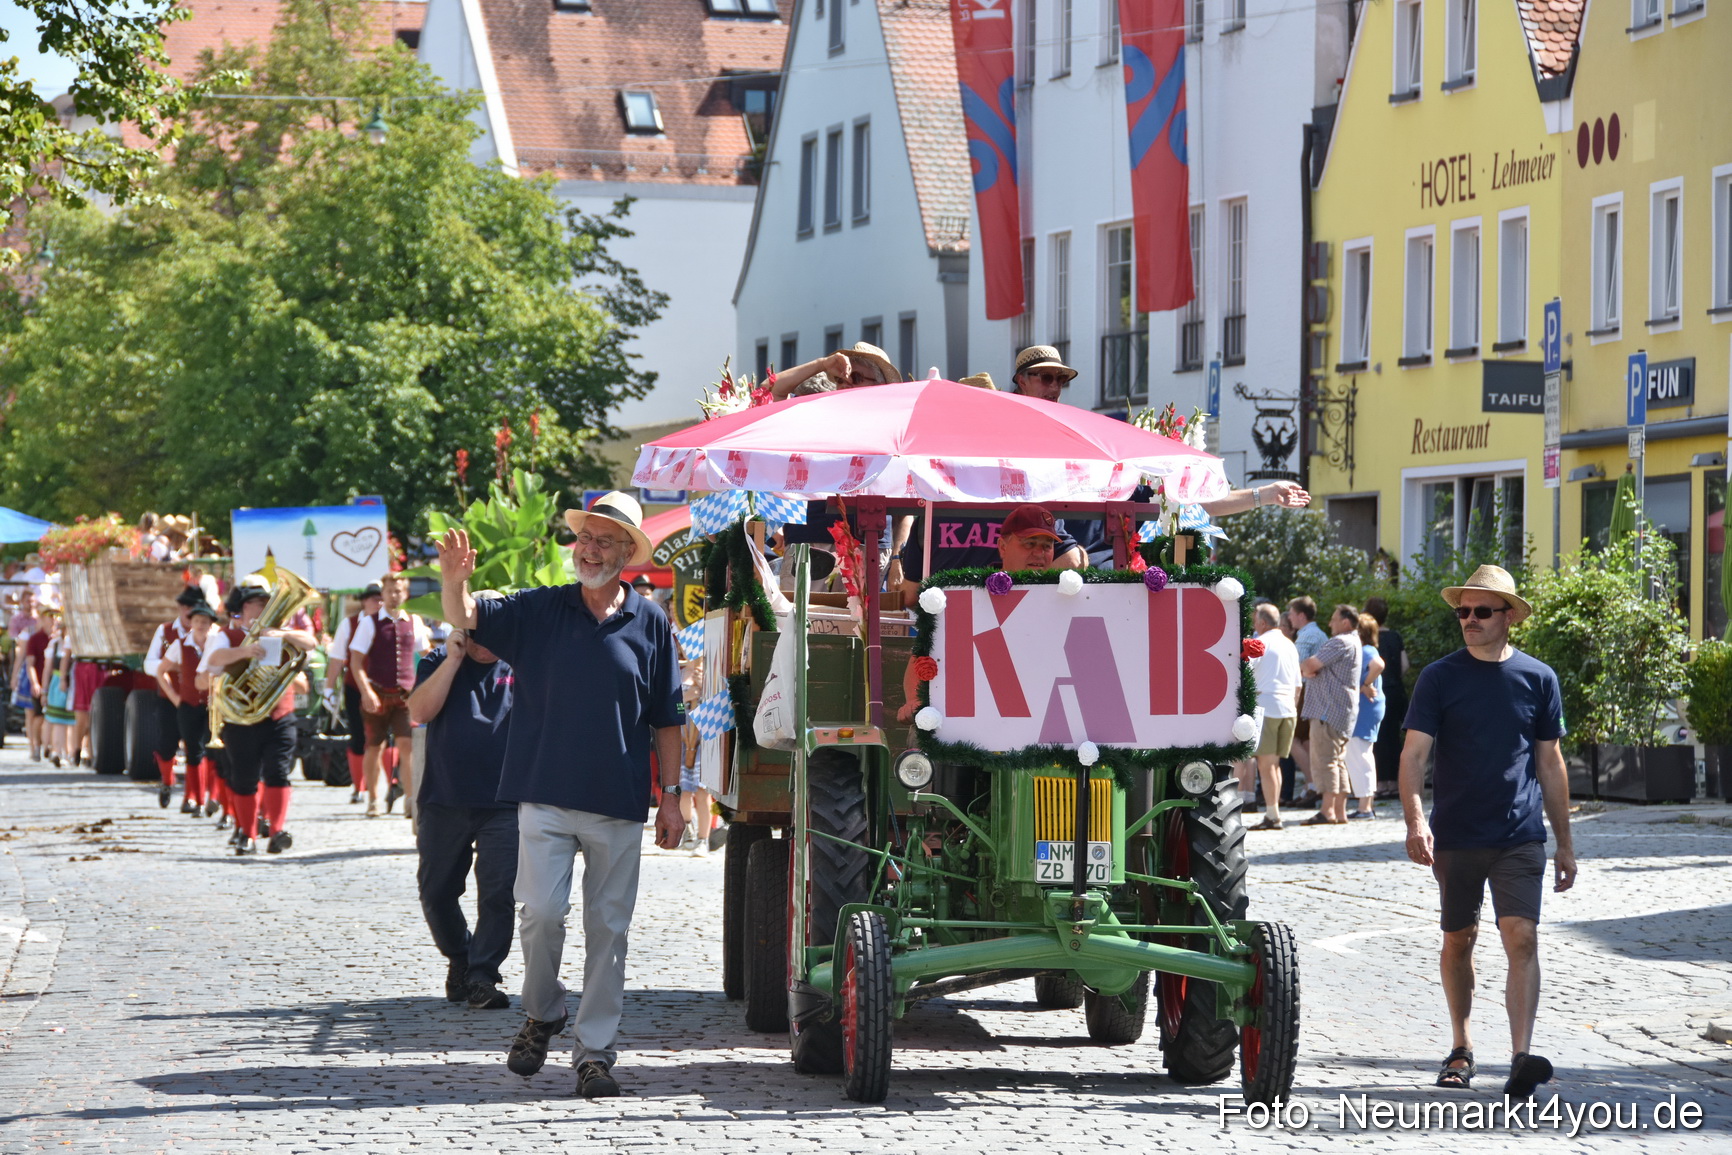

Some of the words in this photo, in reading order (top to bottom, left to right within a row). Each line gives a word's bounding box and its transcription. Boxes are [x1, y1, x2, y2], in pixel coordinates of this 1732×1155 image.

[1421, 152, 1476, 209] HOTEL
[1491, 142, 1555, 190] Lehmeier
[1488, 393, 1545, 406] TAIFU
[1648, 366, 1679, 400] FUN
[1411, 417, 1490, 454] Restaurant
[944, 588, 1228, 743] KAB
[1050, 845, 1073, 861] NM
[1041, 863, 1064, 879] ZB
